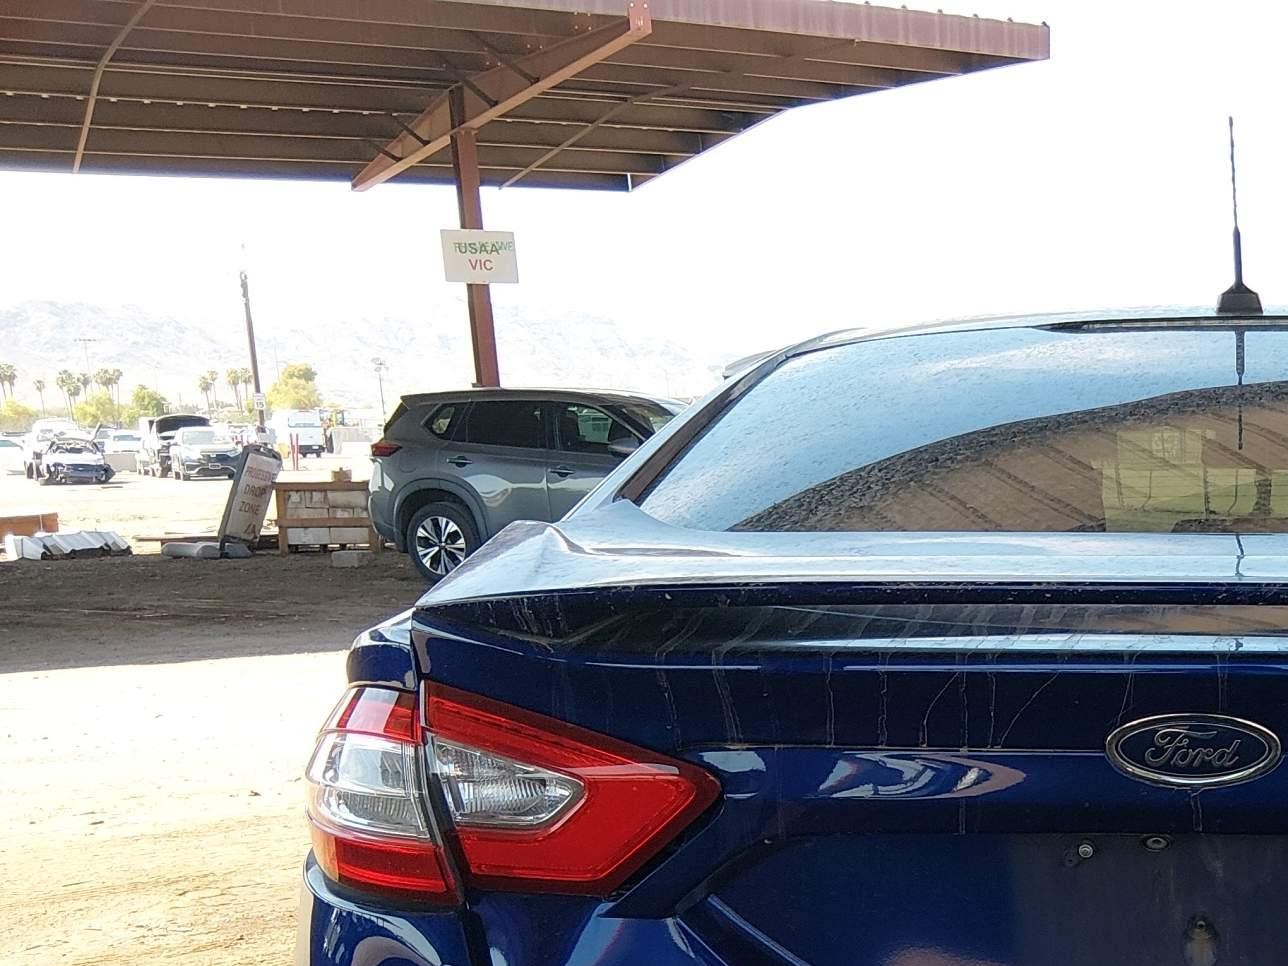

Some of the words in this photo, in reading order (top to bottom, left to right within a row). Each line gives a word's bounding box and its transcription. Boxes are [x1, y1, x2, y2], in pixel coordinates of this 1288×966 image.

[459, 242, 500, 255] USAA
[468, 258, 494, 271] VIC
[244, 483, 268, 498] DROP
[239, 501, 262, 515] ZONE
[1145, 725, 1241, 768] Ford
